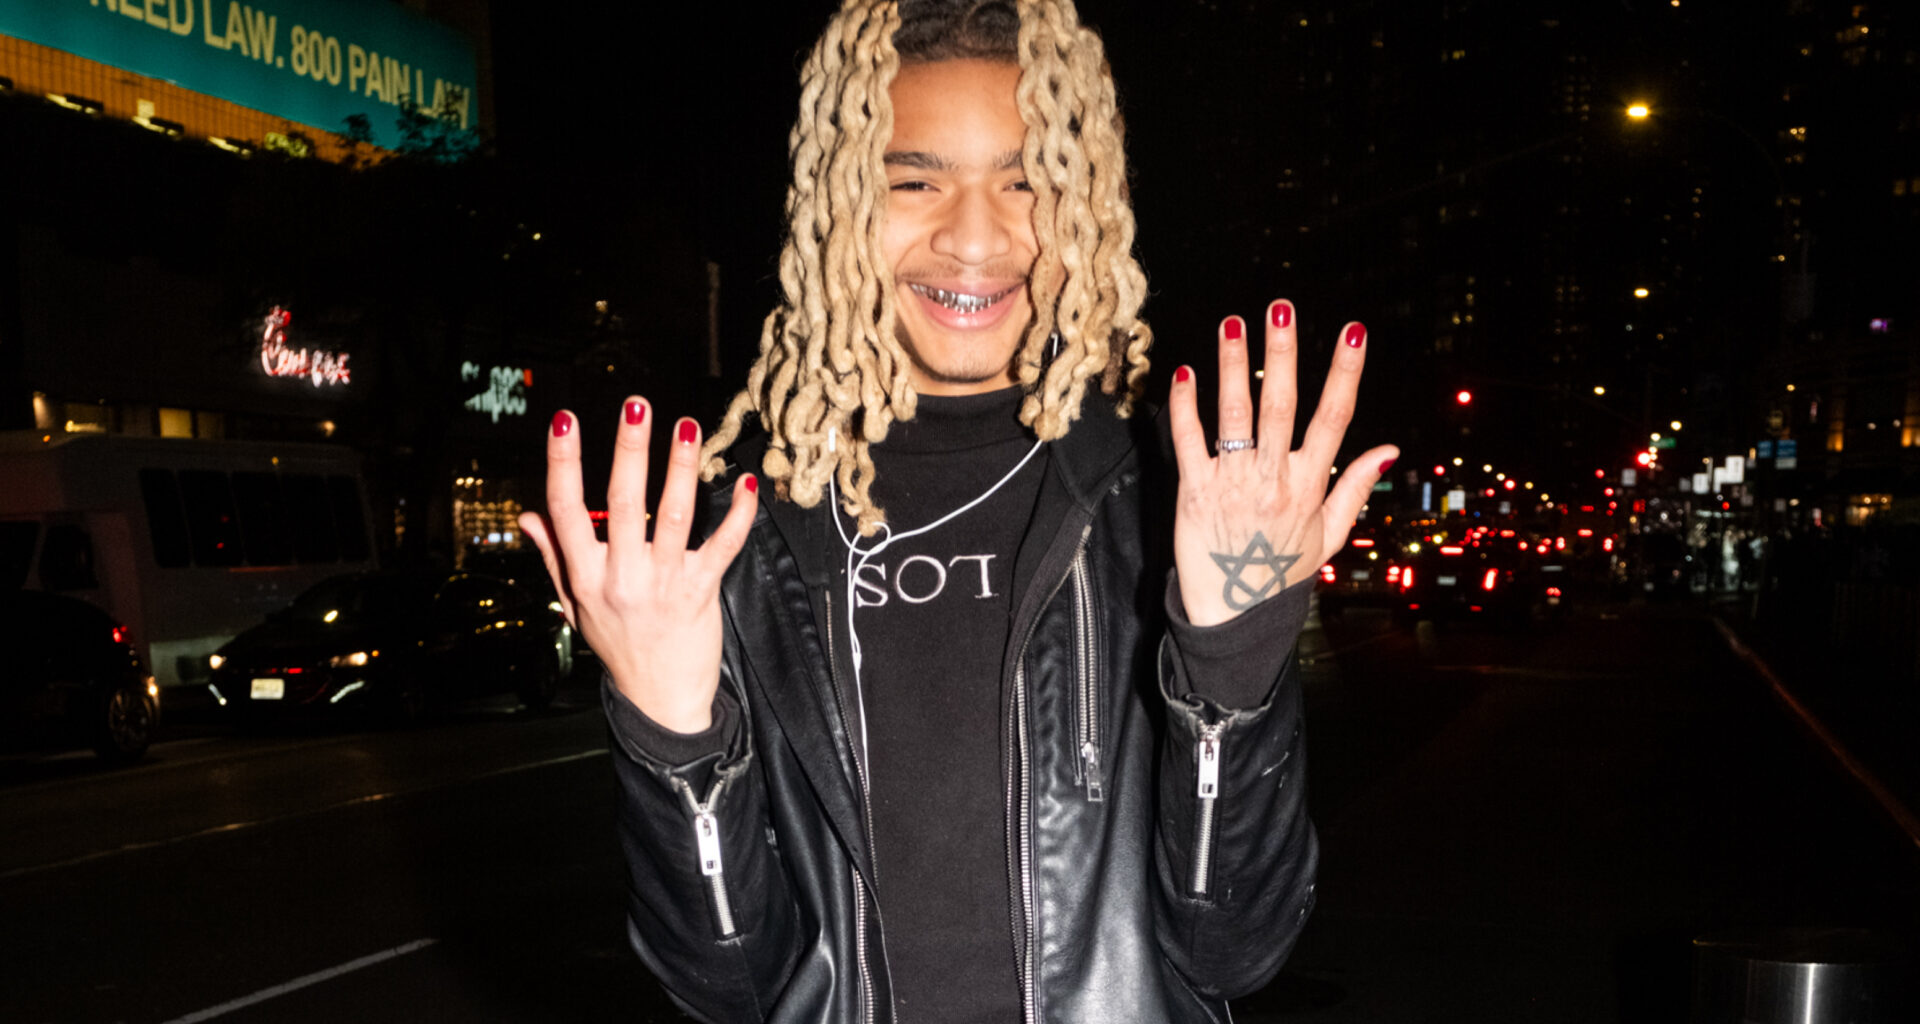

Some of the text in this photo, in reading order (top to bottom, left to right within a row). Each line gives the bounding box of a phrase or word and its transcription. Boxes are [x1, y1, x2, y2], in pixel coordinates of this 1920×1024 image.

[203, 0, 284, 68] LAW.
[291, 25, 342, 86] 800
[348, 43, 410, 110] PAIN
